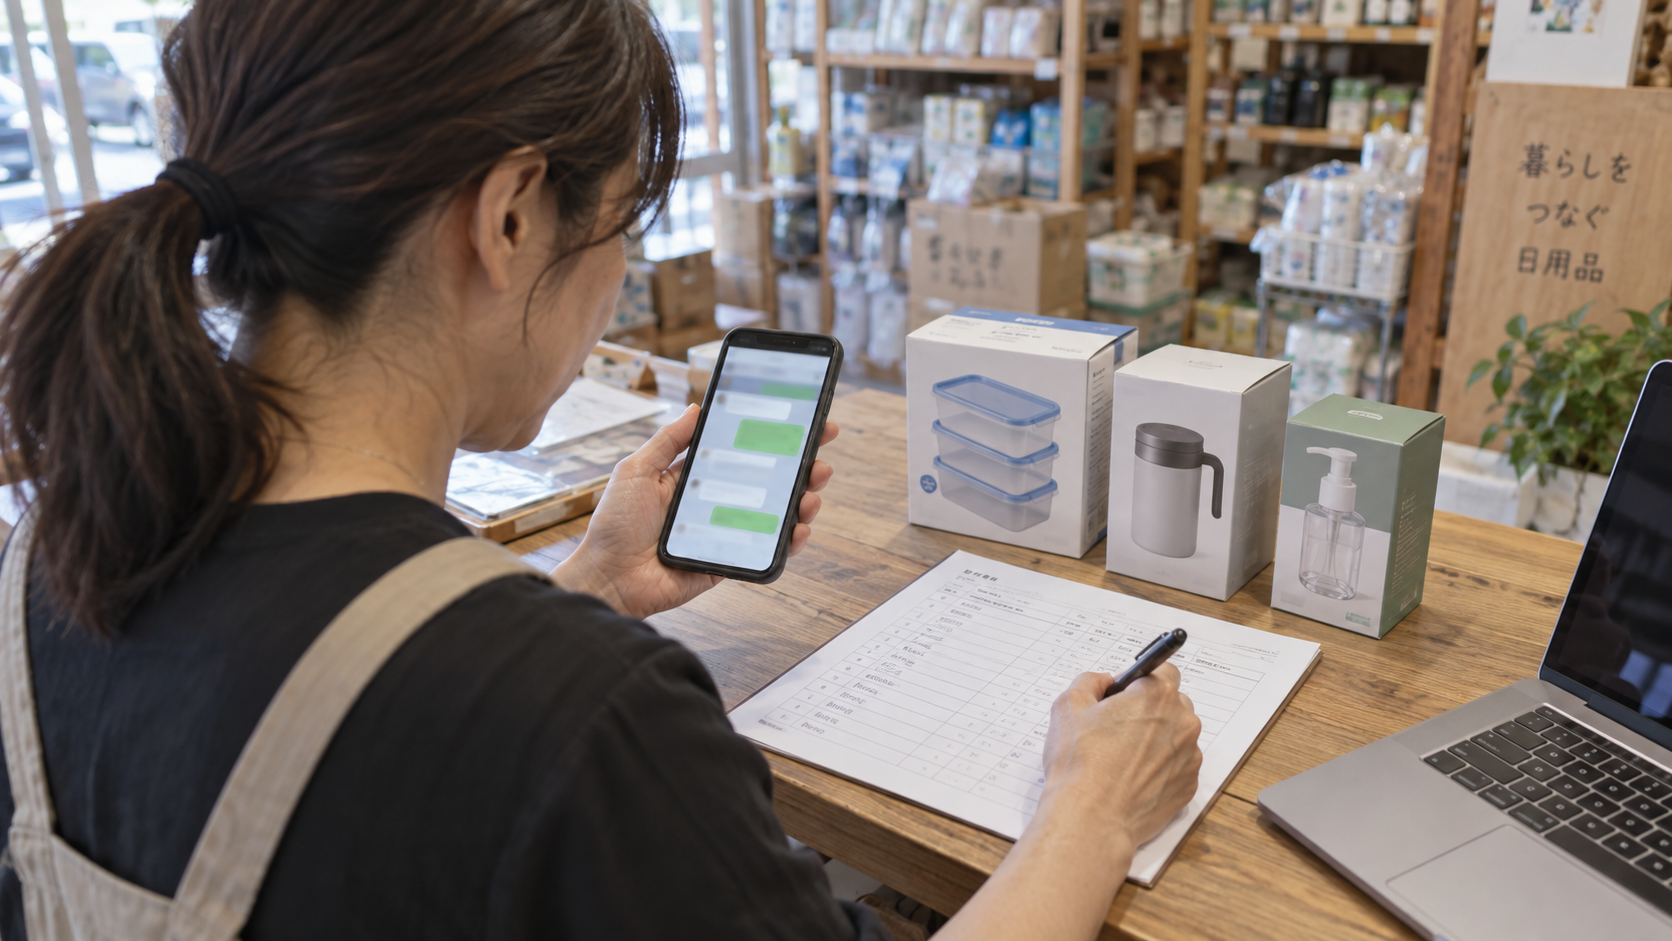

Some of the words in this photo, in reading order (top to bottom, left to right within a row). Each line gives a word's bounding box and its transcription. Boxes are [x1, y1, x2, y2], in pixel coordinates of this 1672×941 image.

[1518, 142, 1631, 183] 暮らしを
[1527, 200, 1609, 229] つなぐ
[1518, 246, 1604, 282] 日用品
